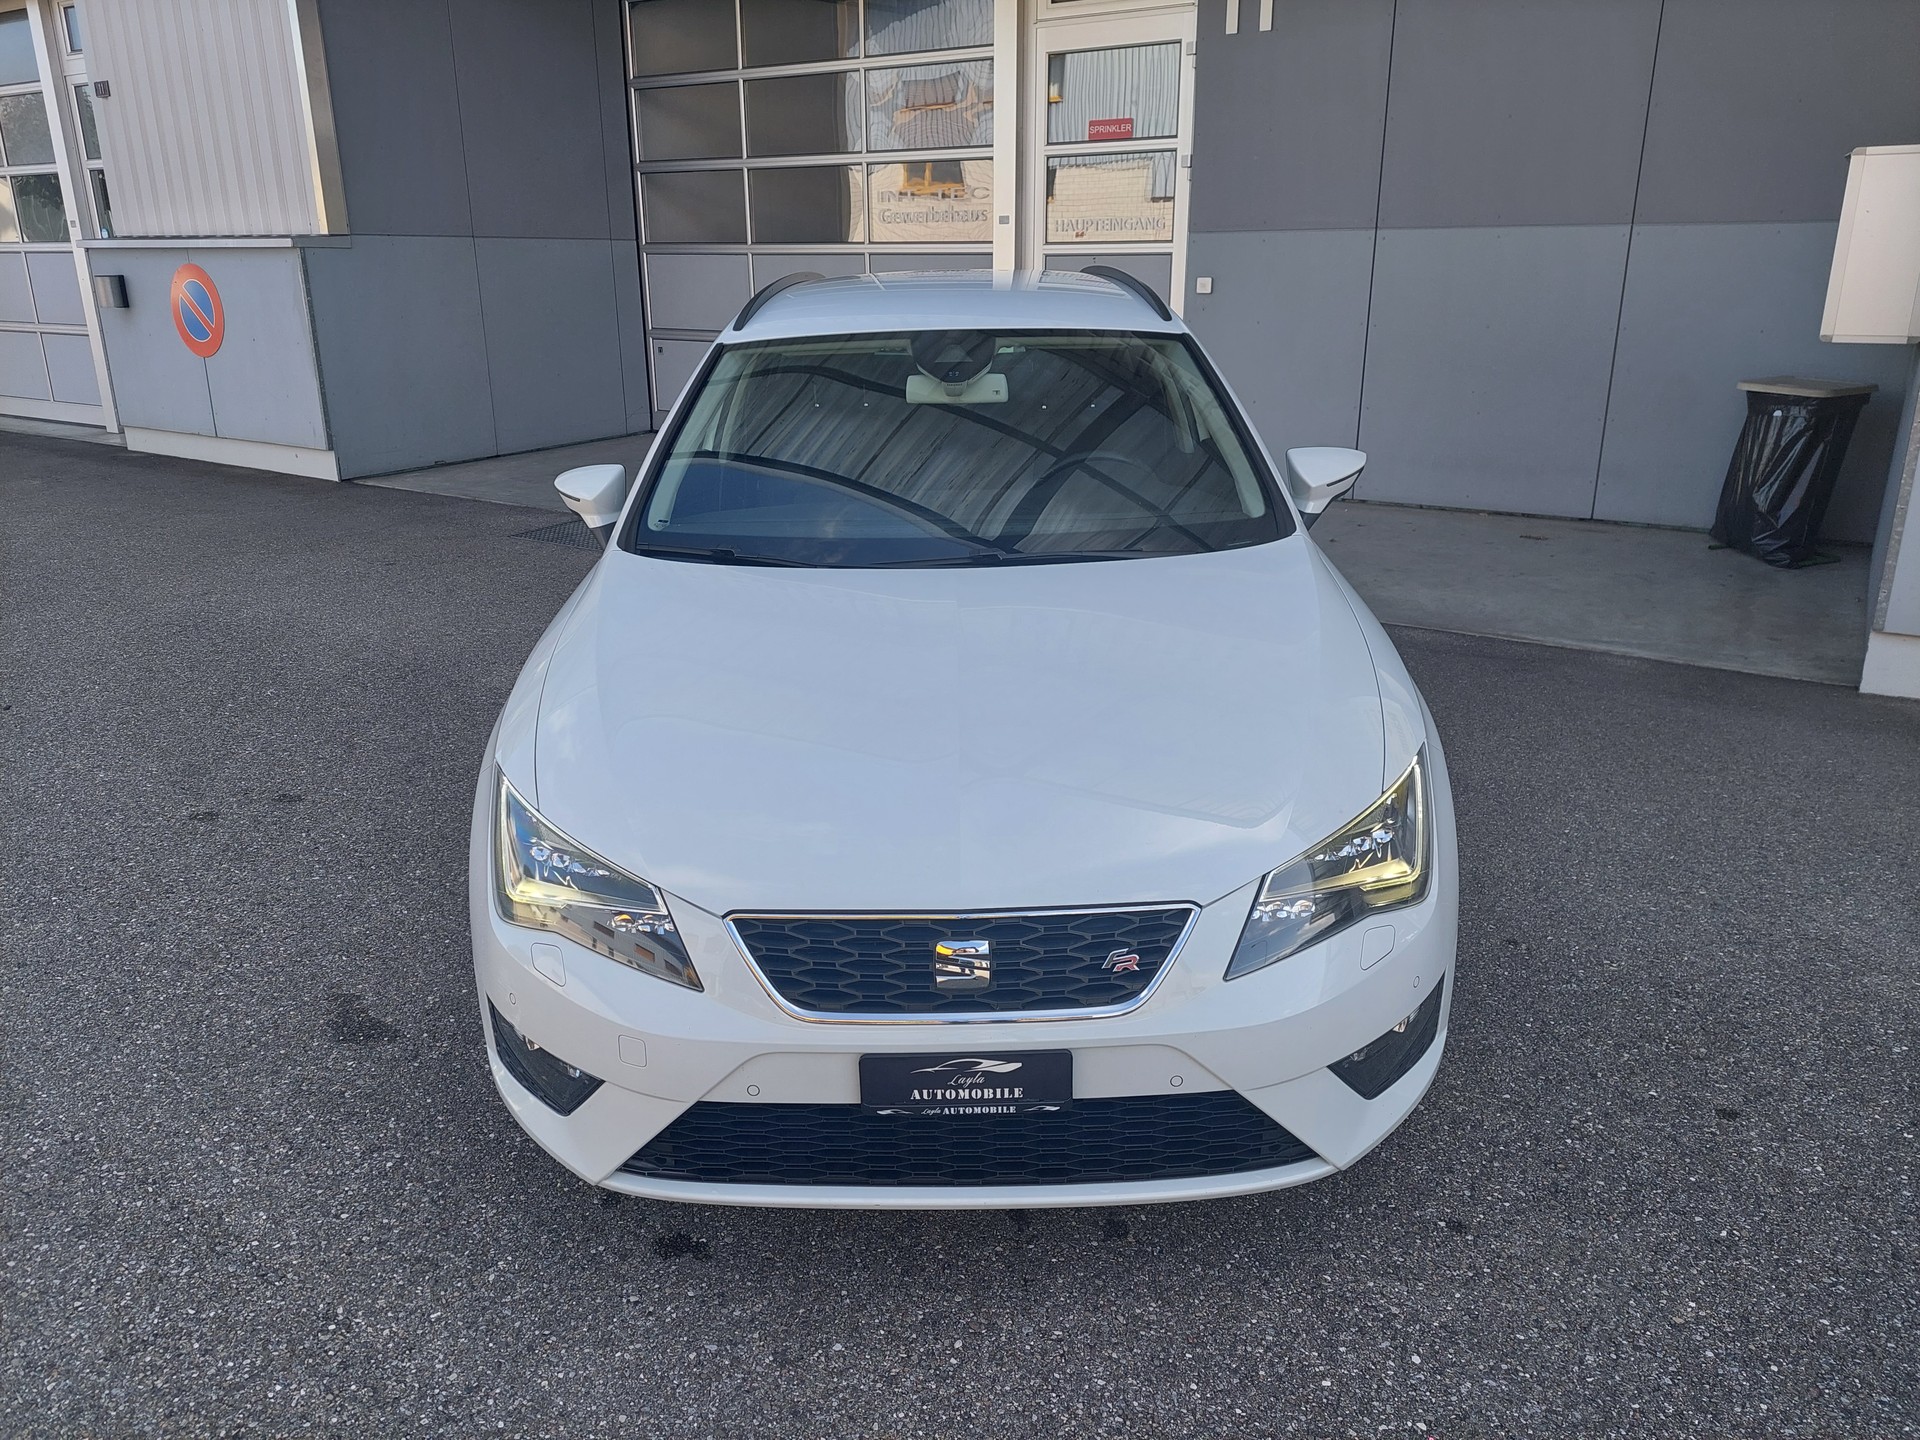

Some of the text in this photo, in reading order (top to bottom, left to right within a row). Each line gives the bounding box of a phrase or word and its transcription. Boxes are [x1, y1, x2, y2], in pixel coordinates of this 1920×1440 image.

[1089, 123, 1132, 134] SPRINKLER
[880, 205, 988, 224] Gewerbehaus
[1055, 217, 1166, 232] HAUPTEINGANG
[1101, 948, 1140, 971] FR
[947, 1072, 985, 1088] Layla
[910, 1087, 1024, 1100] AUTOMOBILE
[921, 1106, 1017, 1116] Layla AUTOMOBILE
